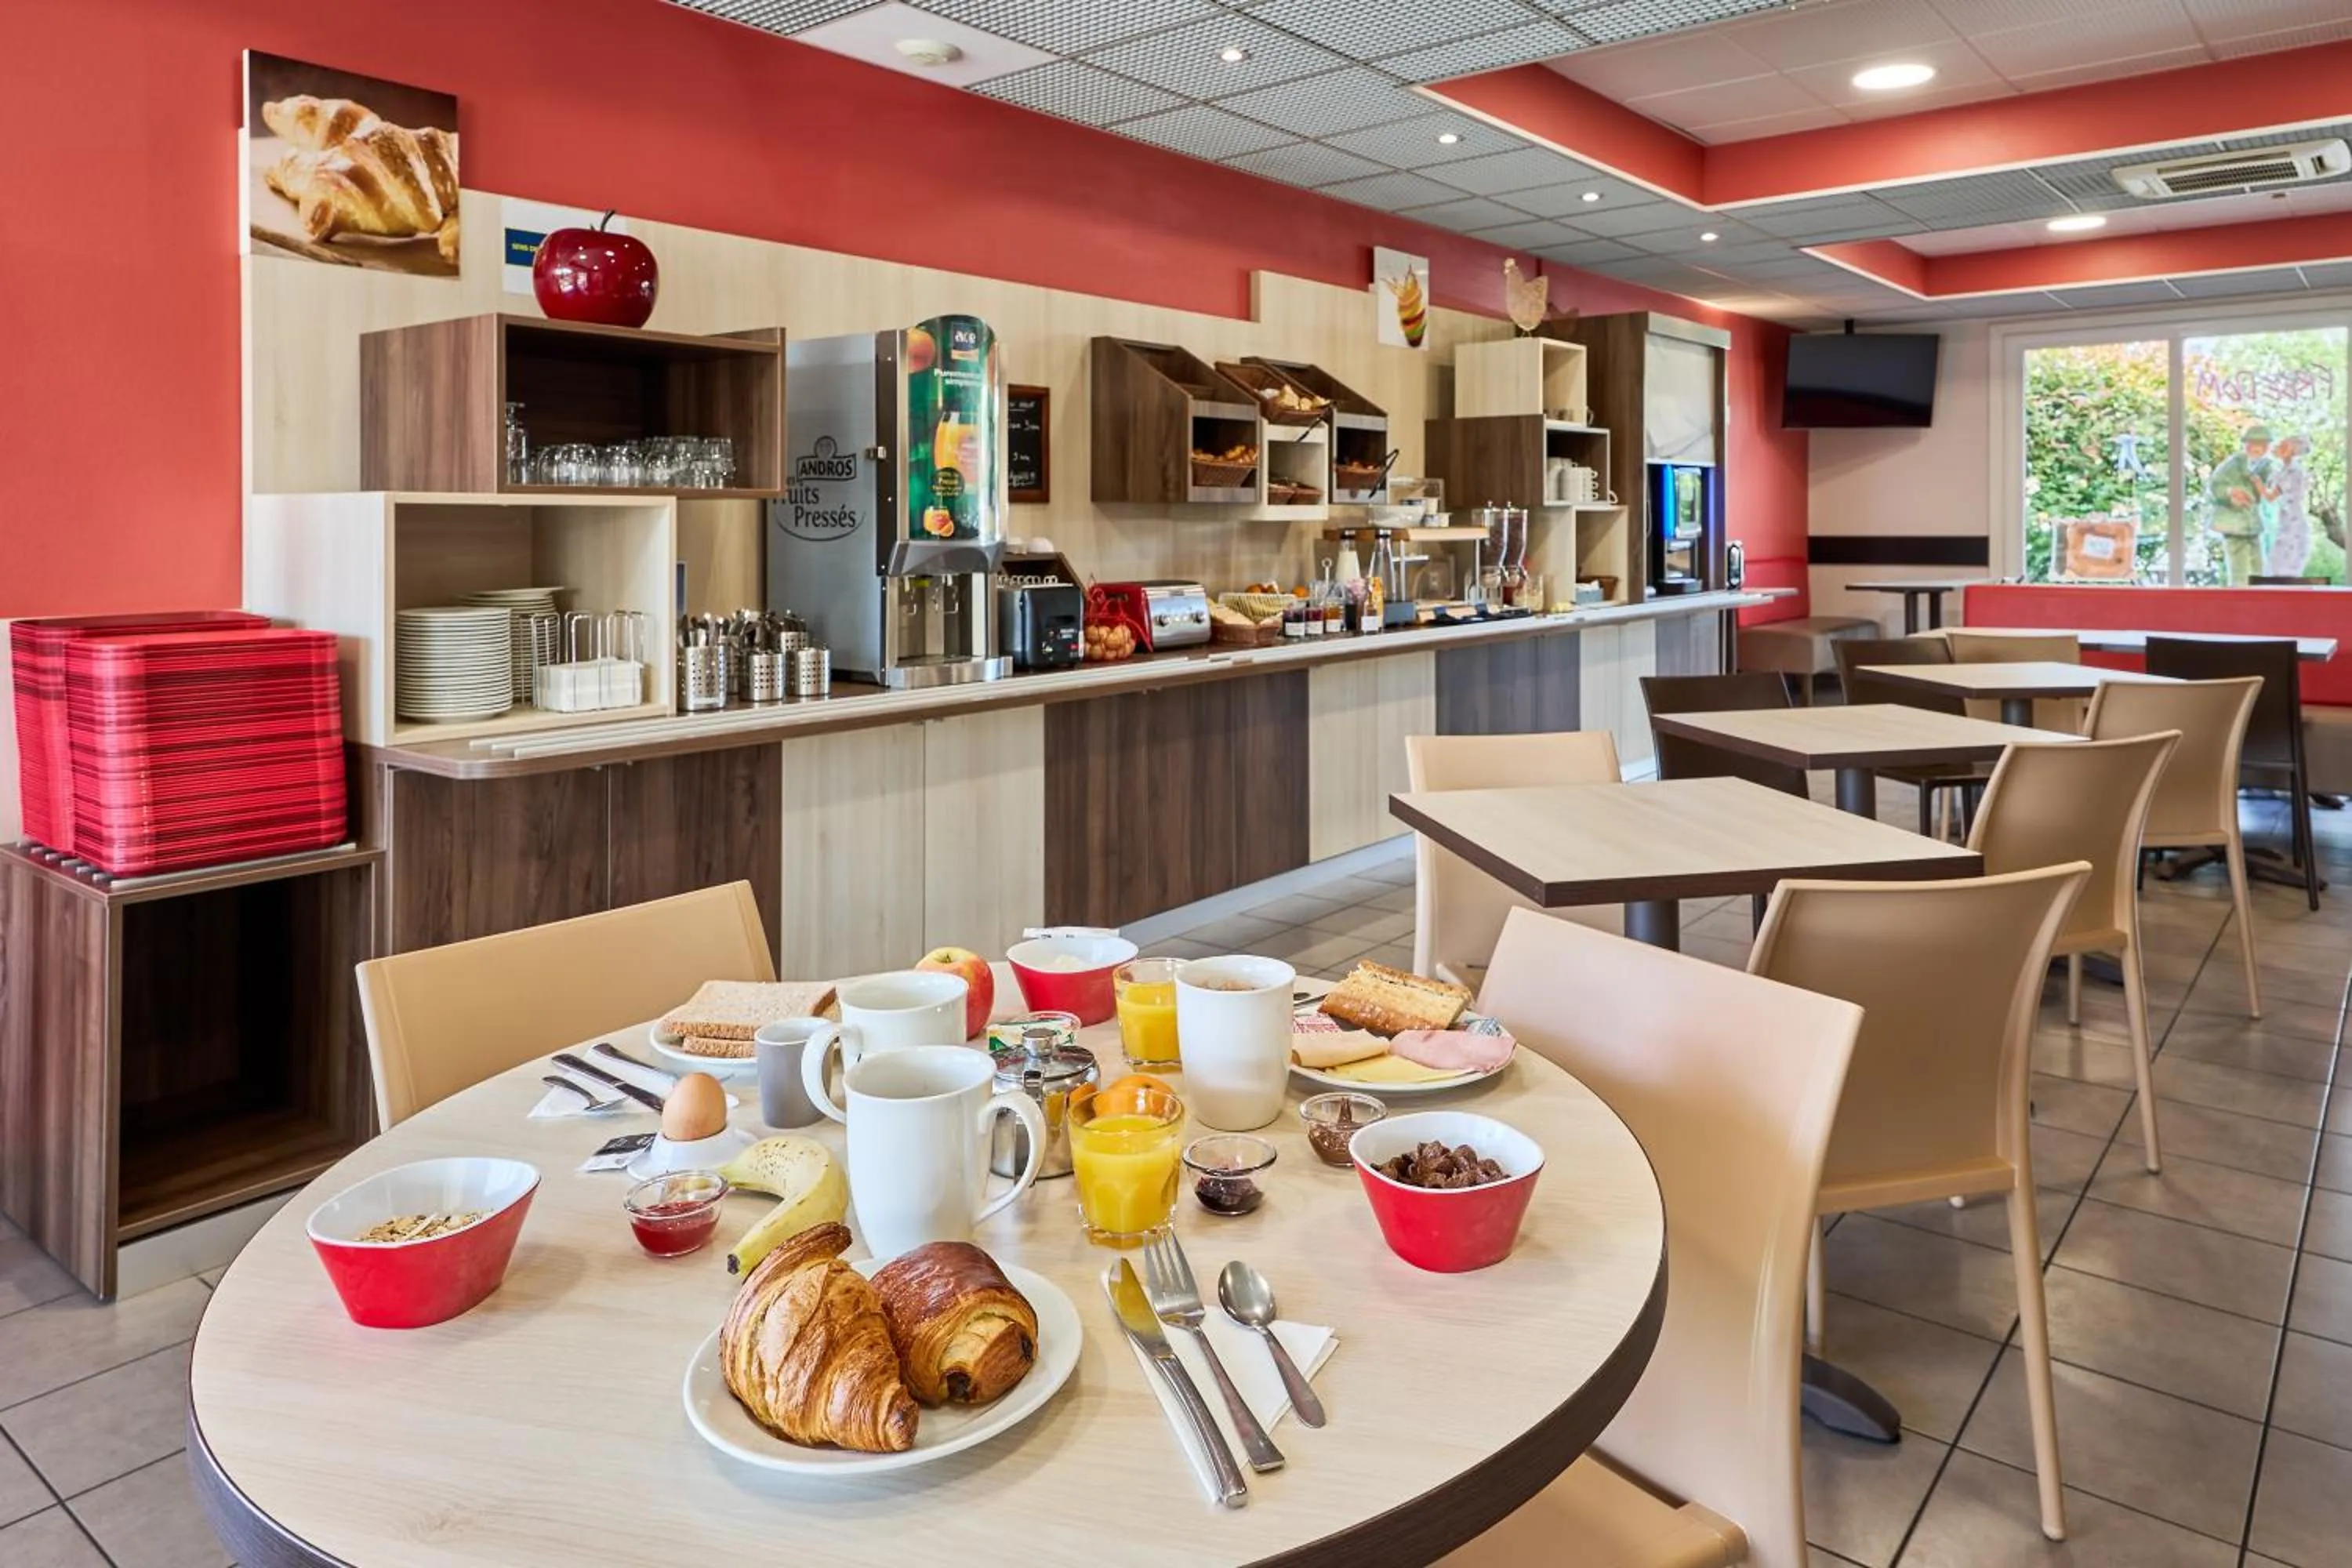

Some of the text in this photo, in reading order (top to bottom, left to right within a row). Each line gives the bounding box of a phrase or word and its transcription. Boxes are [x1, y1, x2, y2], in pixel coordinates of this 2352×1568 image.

[799, 460, 853, 477] ANDROS
[773, 482, 820, 505] uits
[794, 504, 856, 528] Pressés
